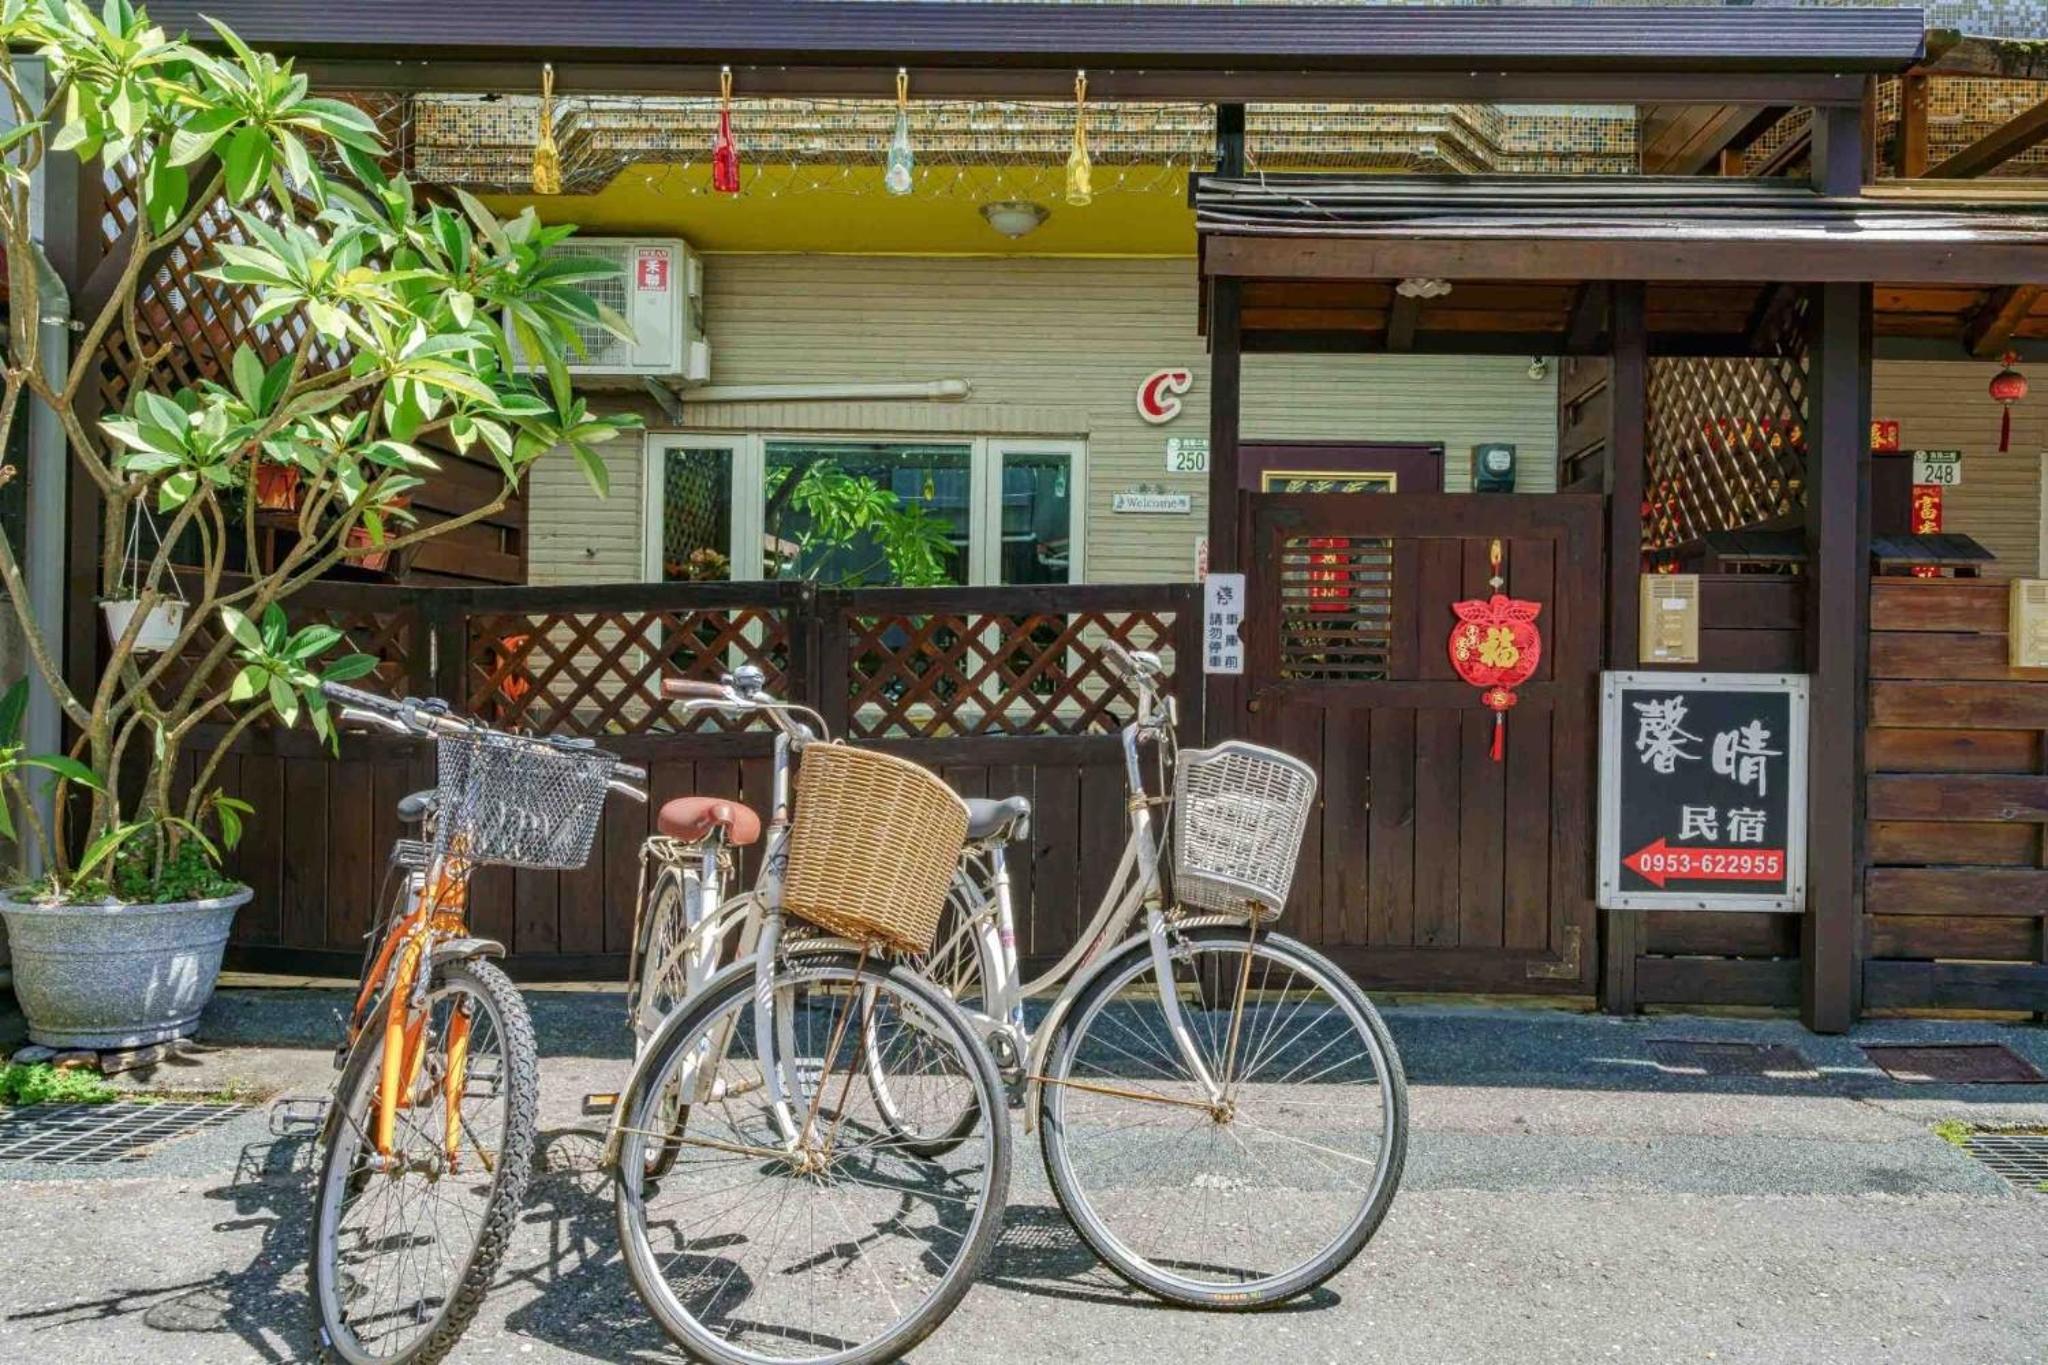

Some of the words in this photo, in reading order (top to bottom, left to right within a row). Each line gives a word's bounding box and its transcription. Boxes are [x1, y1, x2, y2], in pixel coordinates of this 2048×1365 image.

[1176, 452, 1205, 470] 250
[1924, 464, 1954, 484] 248
[1127, 496, 1177, 508] Welcome
[1208, 613, 1223, 667] 請勿停車
[1225, 613, 1239, 669] 車庫前
[1479, 627, 1519, 668] 福
[1678, 805, 1768, 842] 民宿
[1639, 853, 1780, 875] 0953-622955
